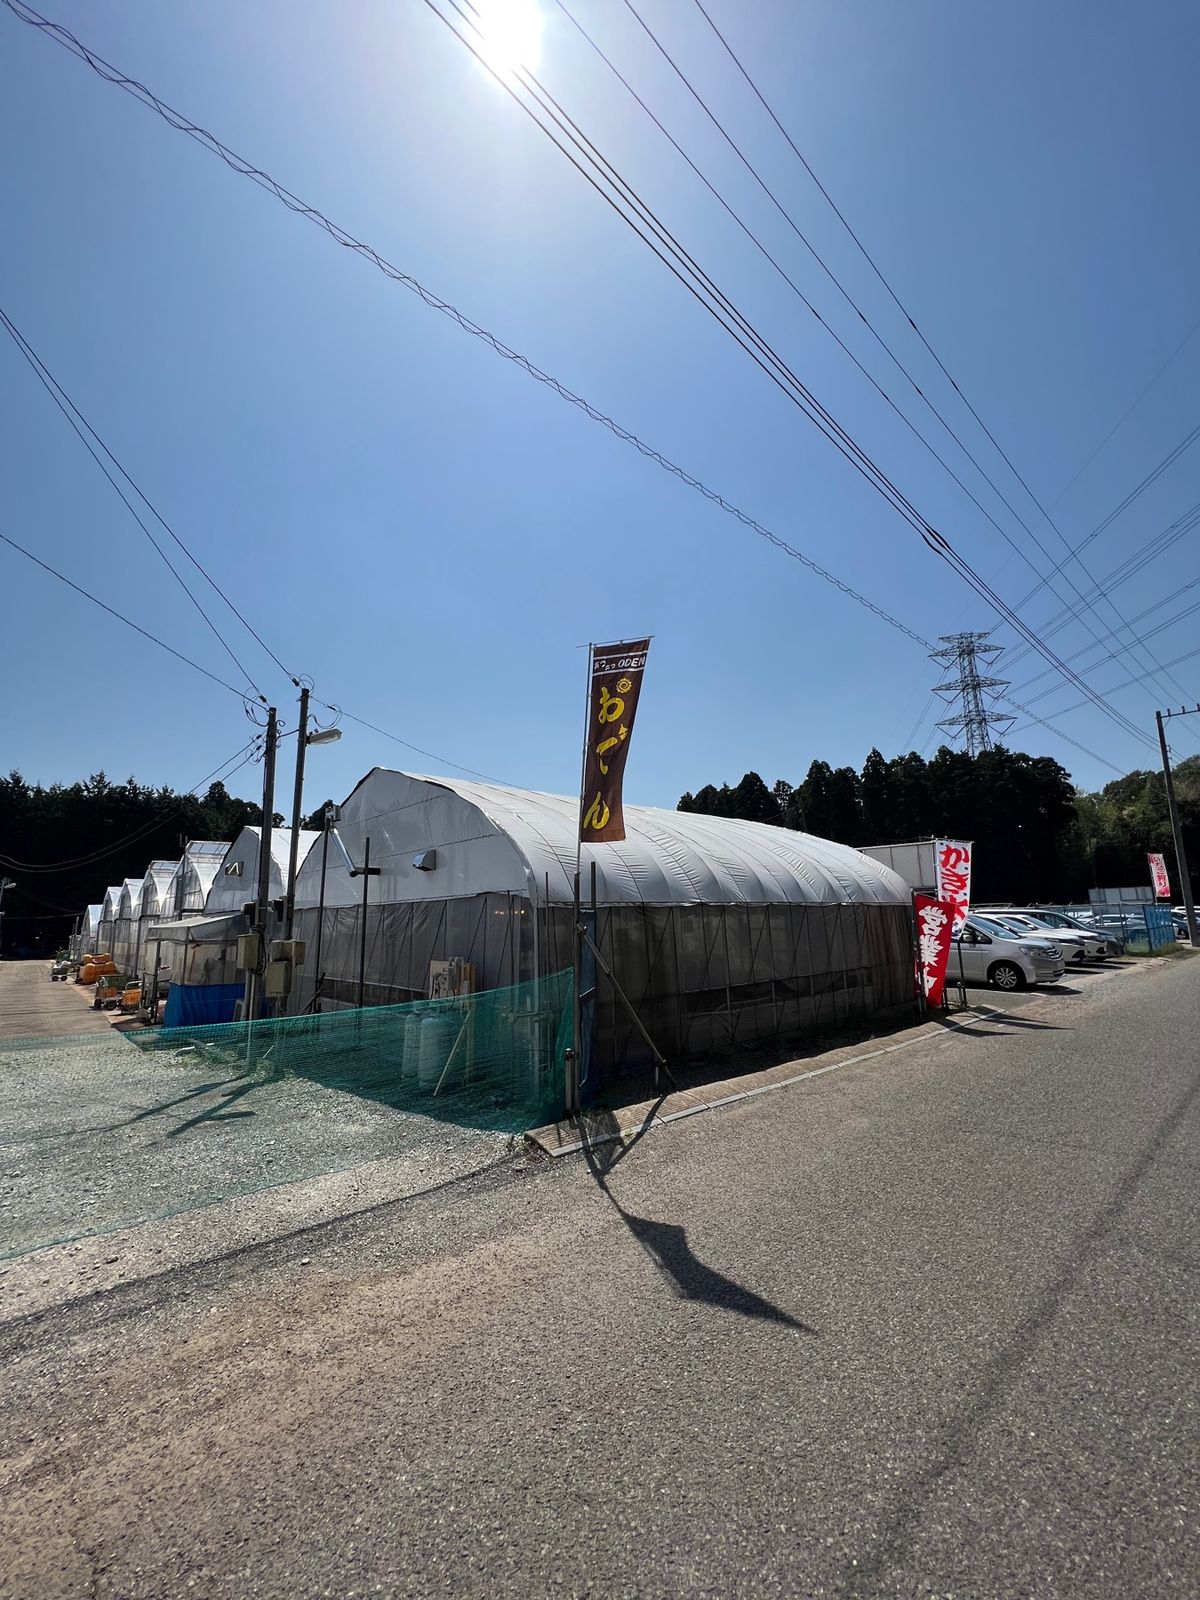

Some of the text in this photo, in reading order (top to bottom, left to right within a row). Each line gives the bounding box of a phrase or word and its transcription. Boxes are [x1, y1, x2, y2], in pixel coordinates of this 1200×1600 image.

[617, 656, 646, 668] ODEN
[583, 687, 629, 830] おでん
[918, 905, 948, 997] 営業中
